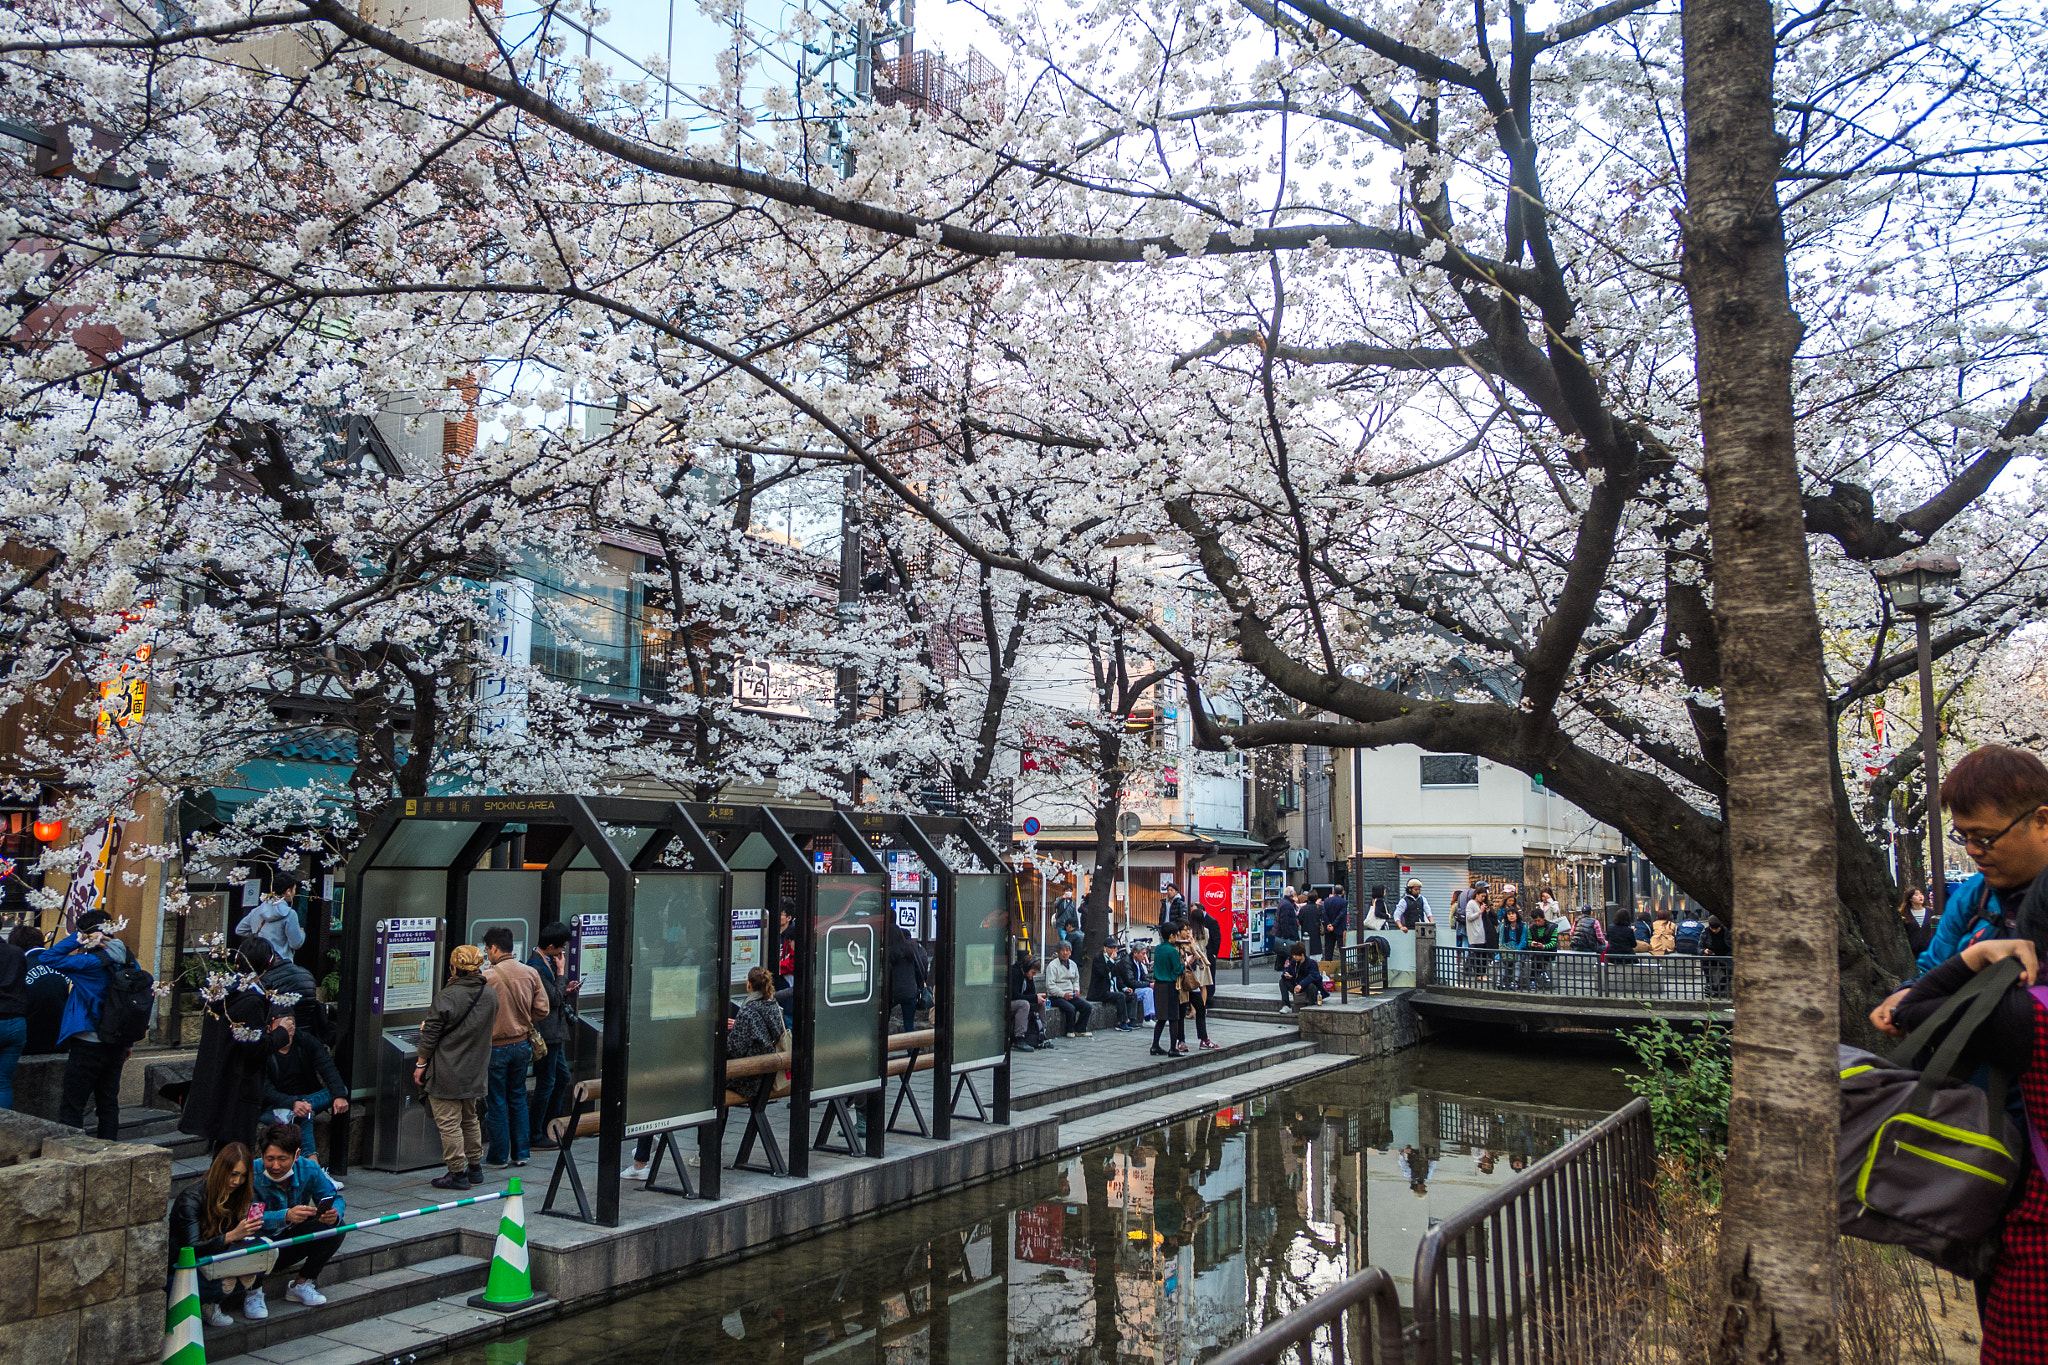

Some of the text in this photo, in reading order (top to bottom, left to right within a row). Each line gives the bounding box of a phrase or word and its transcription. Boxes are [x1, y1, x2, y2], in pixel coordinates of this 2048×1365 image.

[423, 800, 471, 815] 喫煙場所
[484, 800, 556, 812] SMOKING AREA
[1205, 890, 1224, 899] Coca-Cola
[401, 919, 432, 927] 喫煙場所
[373, 937, 383, 1005] 喫煙場所
